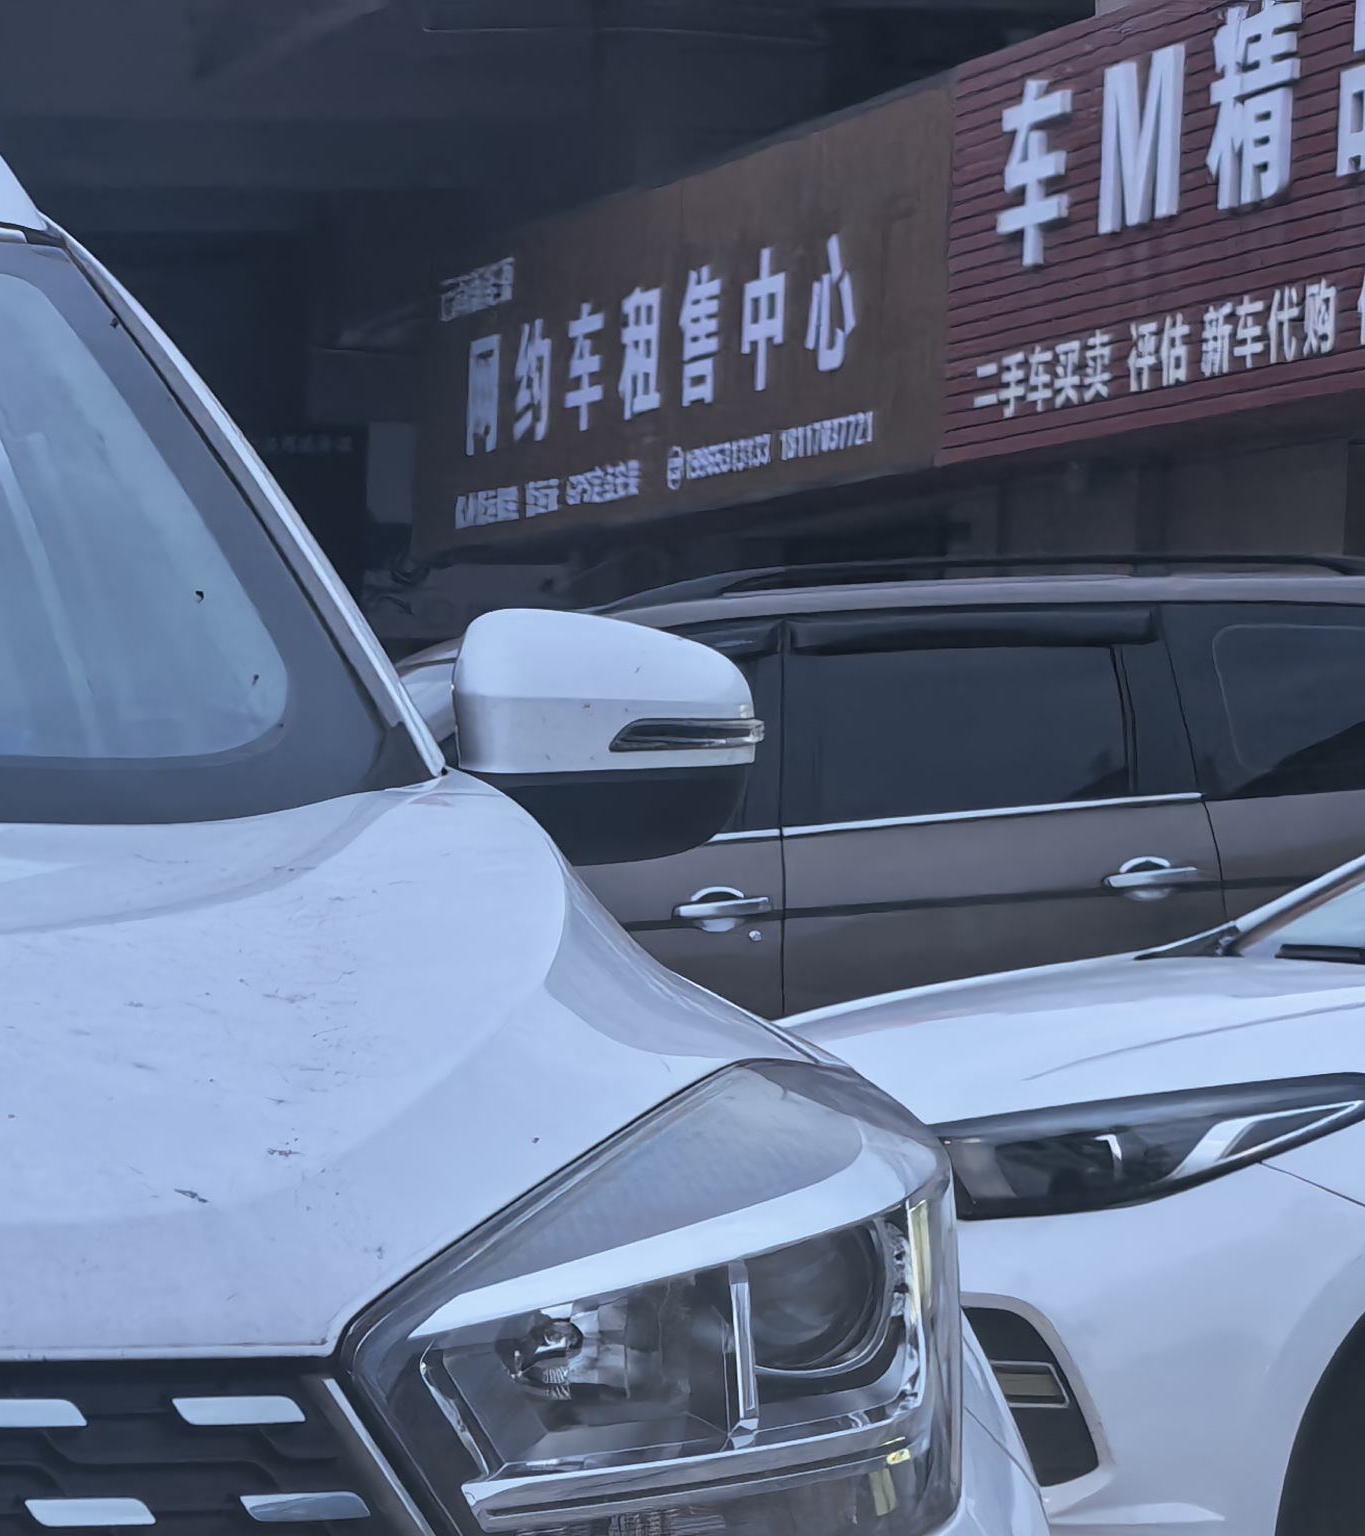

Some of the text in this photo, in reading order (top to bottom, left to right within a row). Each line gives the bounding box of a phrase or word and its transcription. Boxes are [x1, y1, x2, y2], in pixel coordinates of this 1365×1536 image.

[464, 234, 858, 457] 网约车租售中心
[973, 329, 1113, 419] 二手车买卖
[1127, 312, 1191, 393] 评估
[1200, 278, 1338, 378] 新车代购
